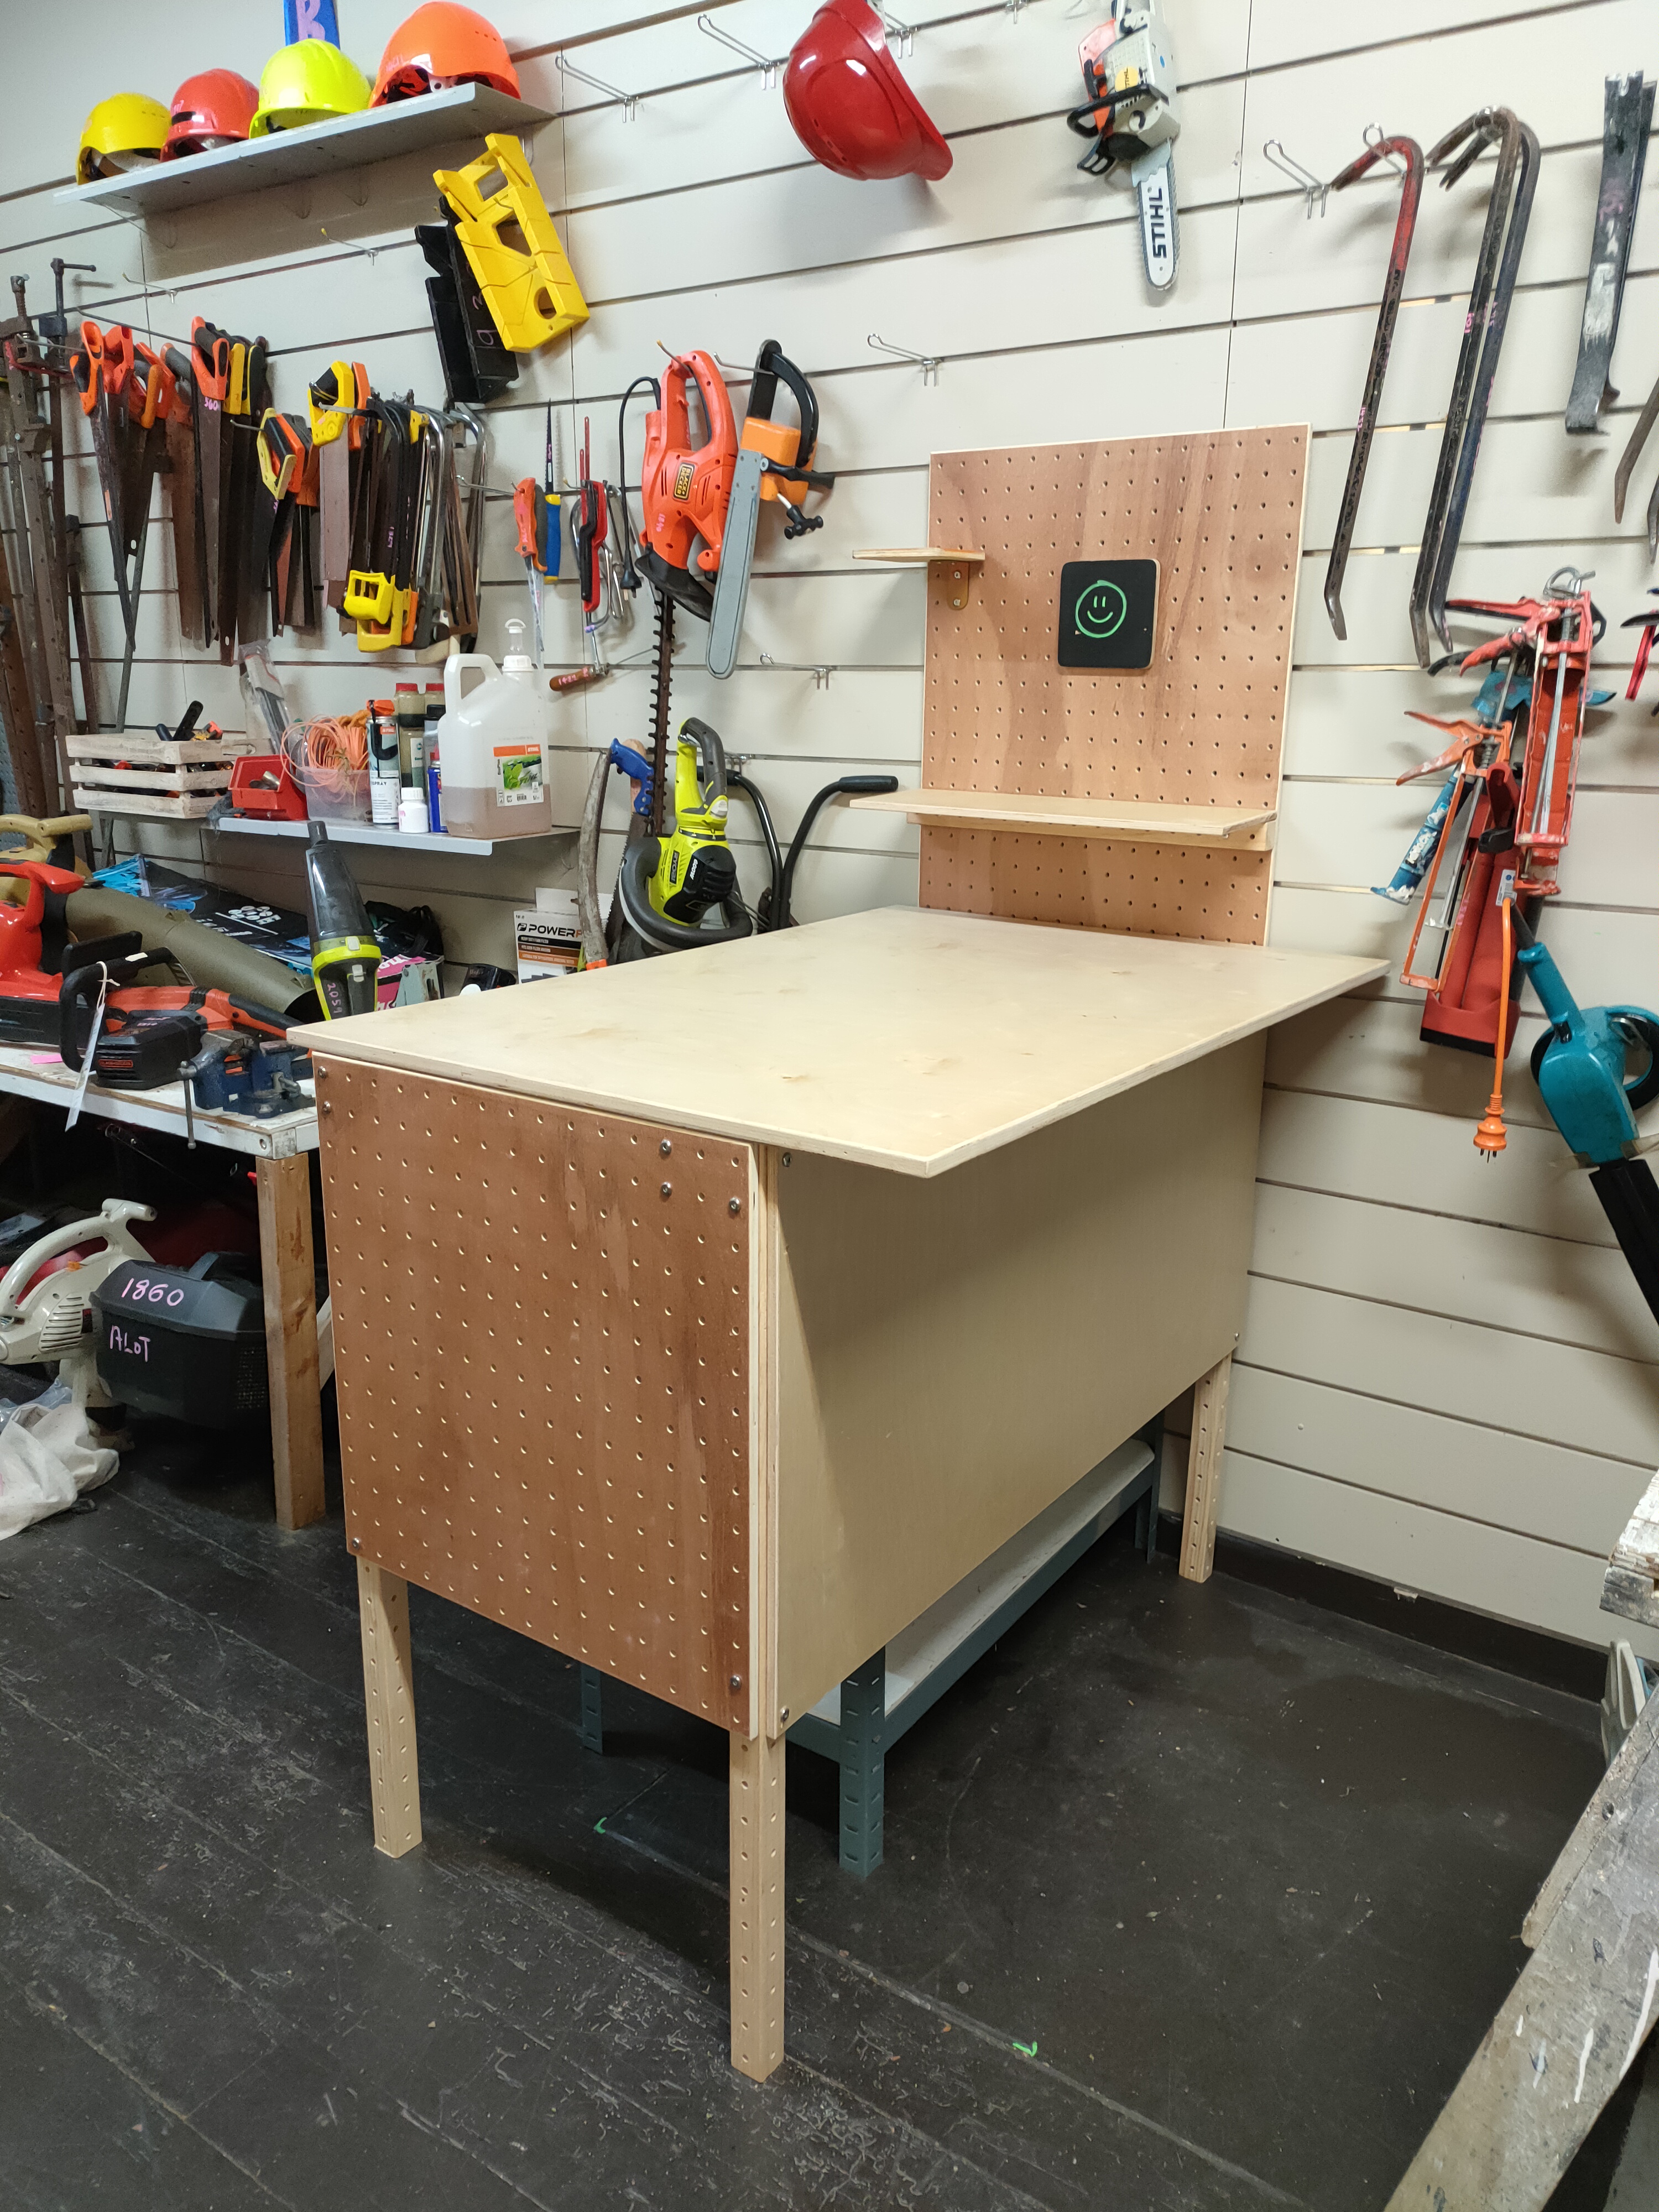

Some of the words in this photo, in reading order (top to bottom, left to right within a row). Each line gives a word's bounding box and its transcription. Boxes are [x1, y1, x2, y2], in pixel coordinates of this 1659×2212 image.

[1149, 187, 1167, 258] STIHL
[690, 858, 698, 880] 600W
[121, 1277, 184, 1306] 1860
